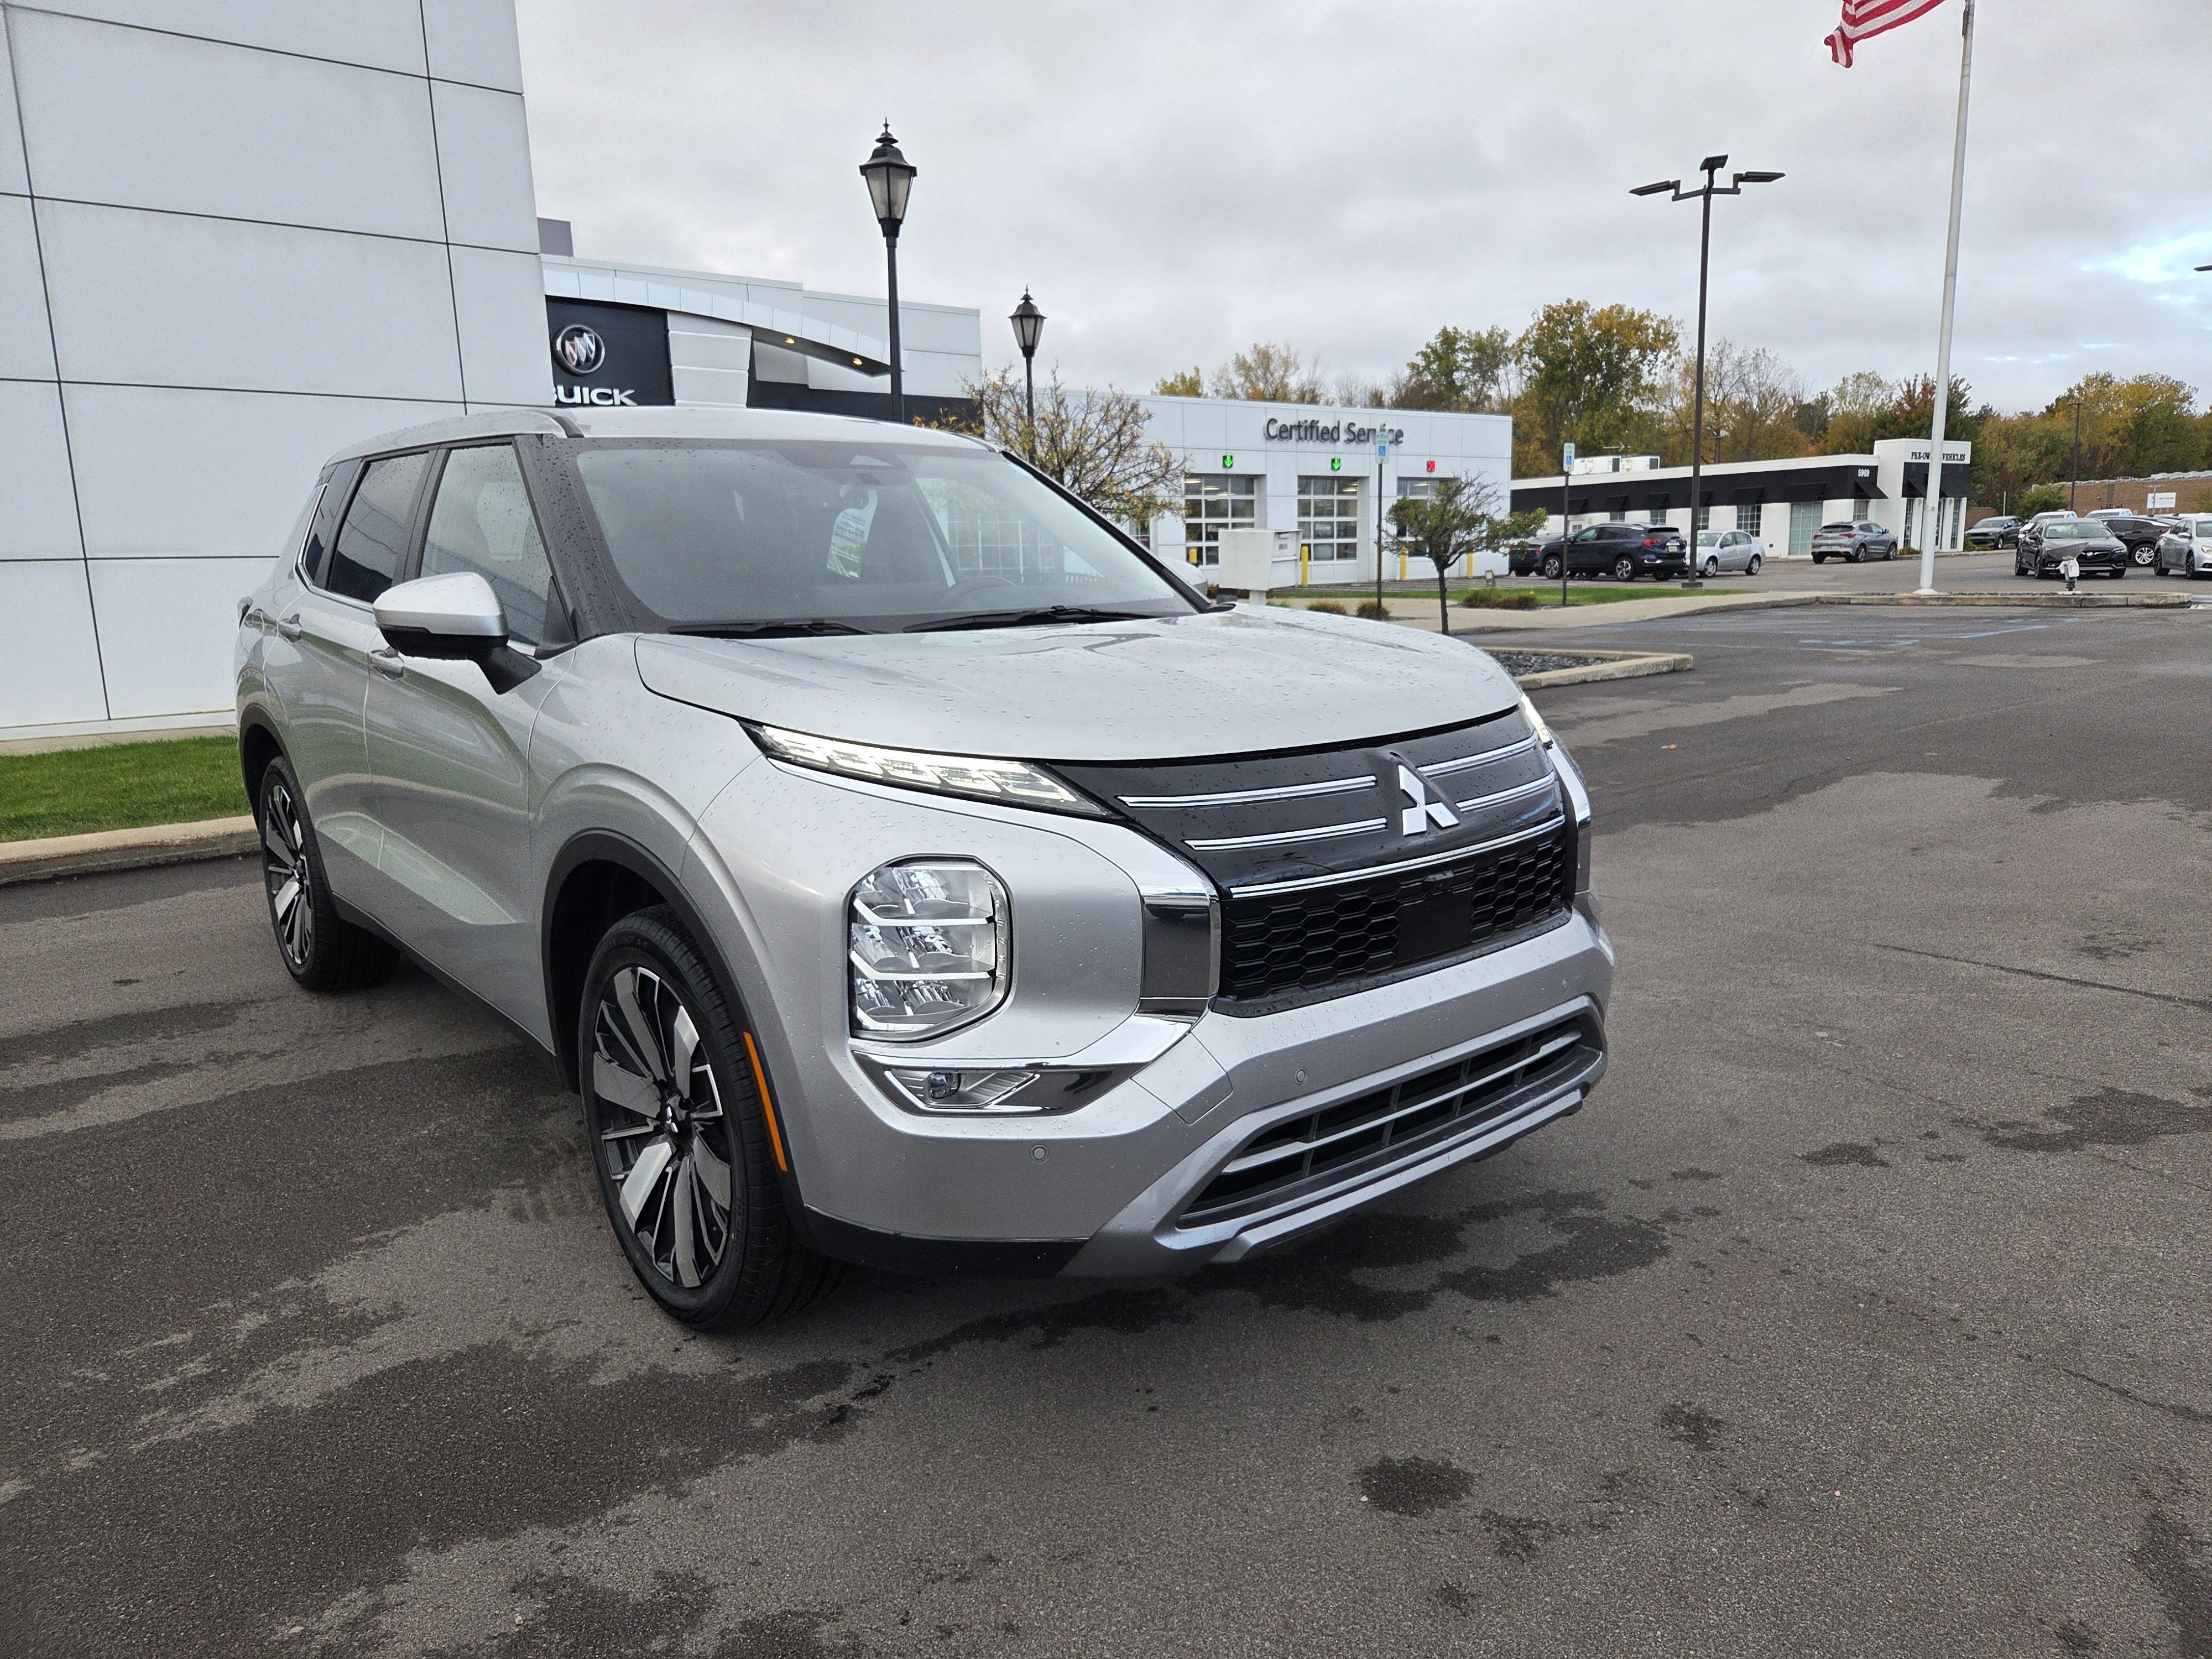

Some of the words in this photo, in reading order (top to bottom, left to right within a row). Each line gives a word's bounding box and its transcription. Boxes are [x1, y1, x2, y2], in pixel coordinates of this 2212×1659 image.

[1264, 418, 1340, 442] Certified
[1344, 422, 1404, 444] Serce
[1911, 451, 1931, 460] PRE-OW
[1942, 453, 1966, 461] VEHICLES
